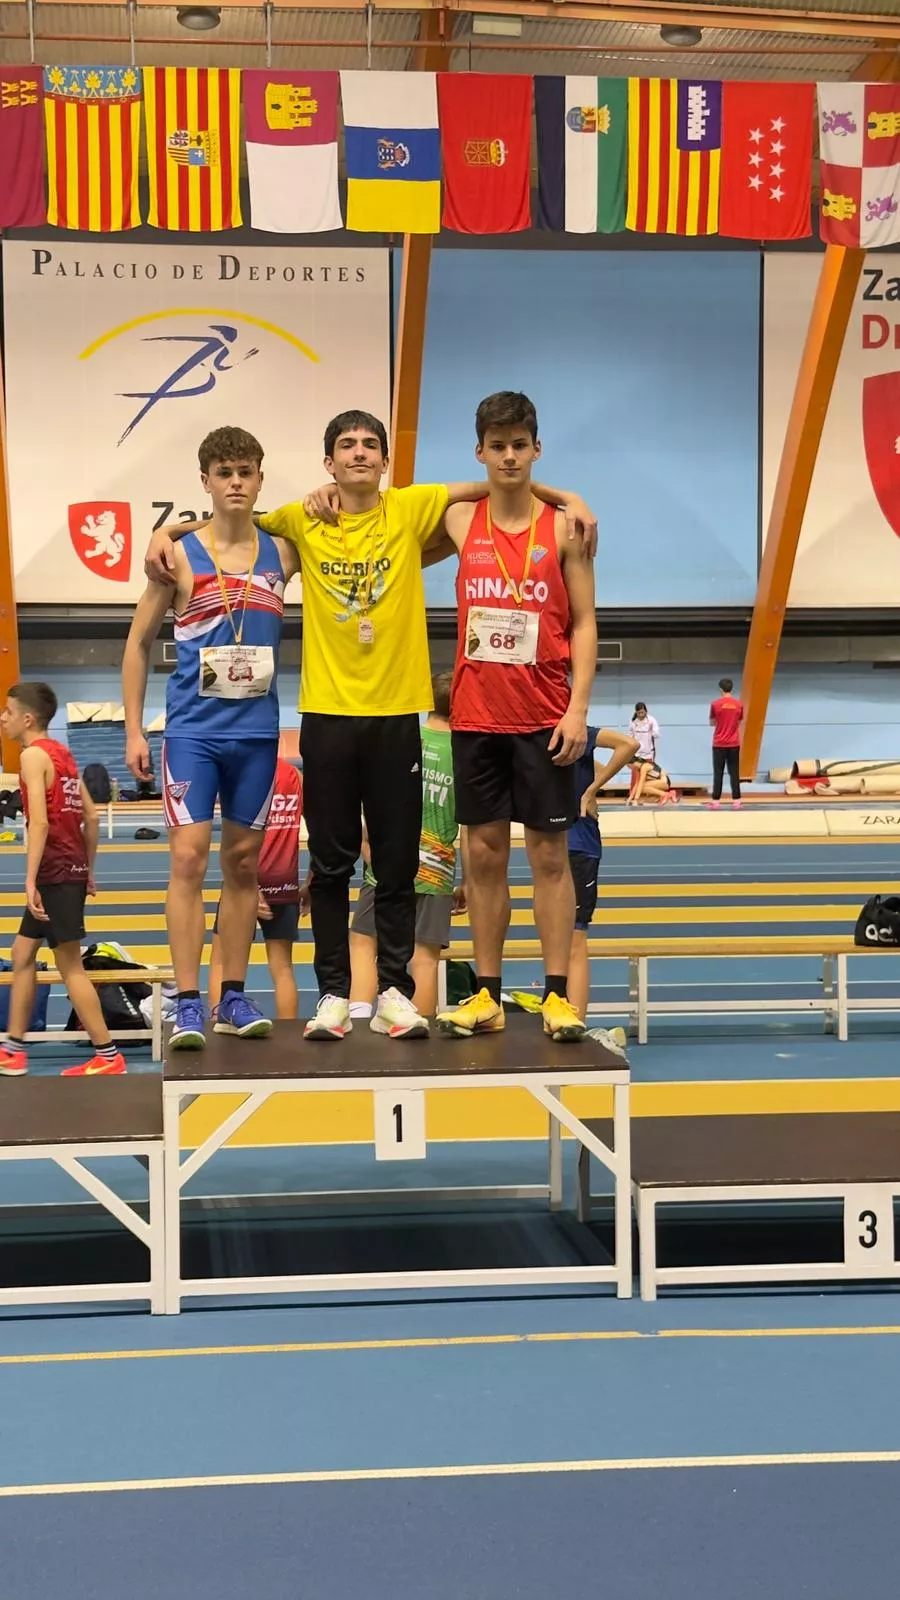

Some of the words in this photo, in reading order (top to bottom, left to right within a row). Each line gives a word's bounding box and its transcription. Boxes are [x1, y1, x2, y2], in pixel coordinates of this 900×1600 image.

[31, 249, 158, 280] PALACIO
[172, 264, 204, 280] DE
[218, 254, 366, 282] DEPORTES
[489, 632, 516, 650] 68
[392, 1103, 403, 1143] 1
[858, 1209, 878, 1249] 3
